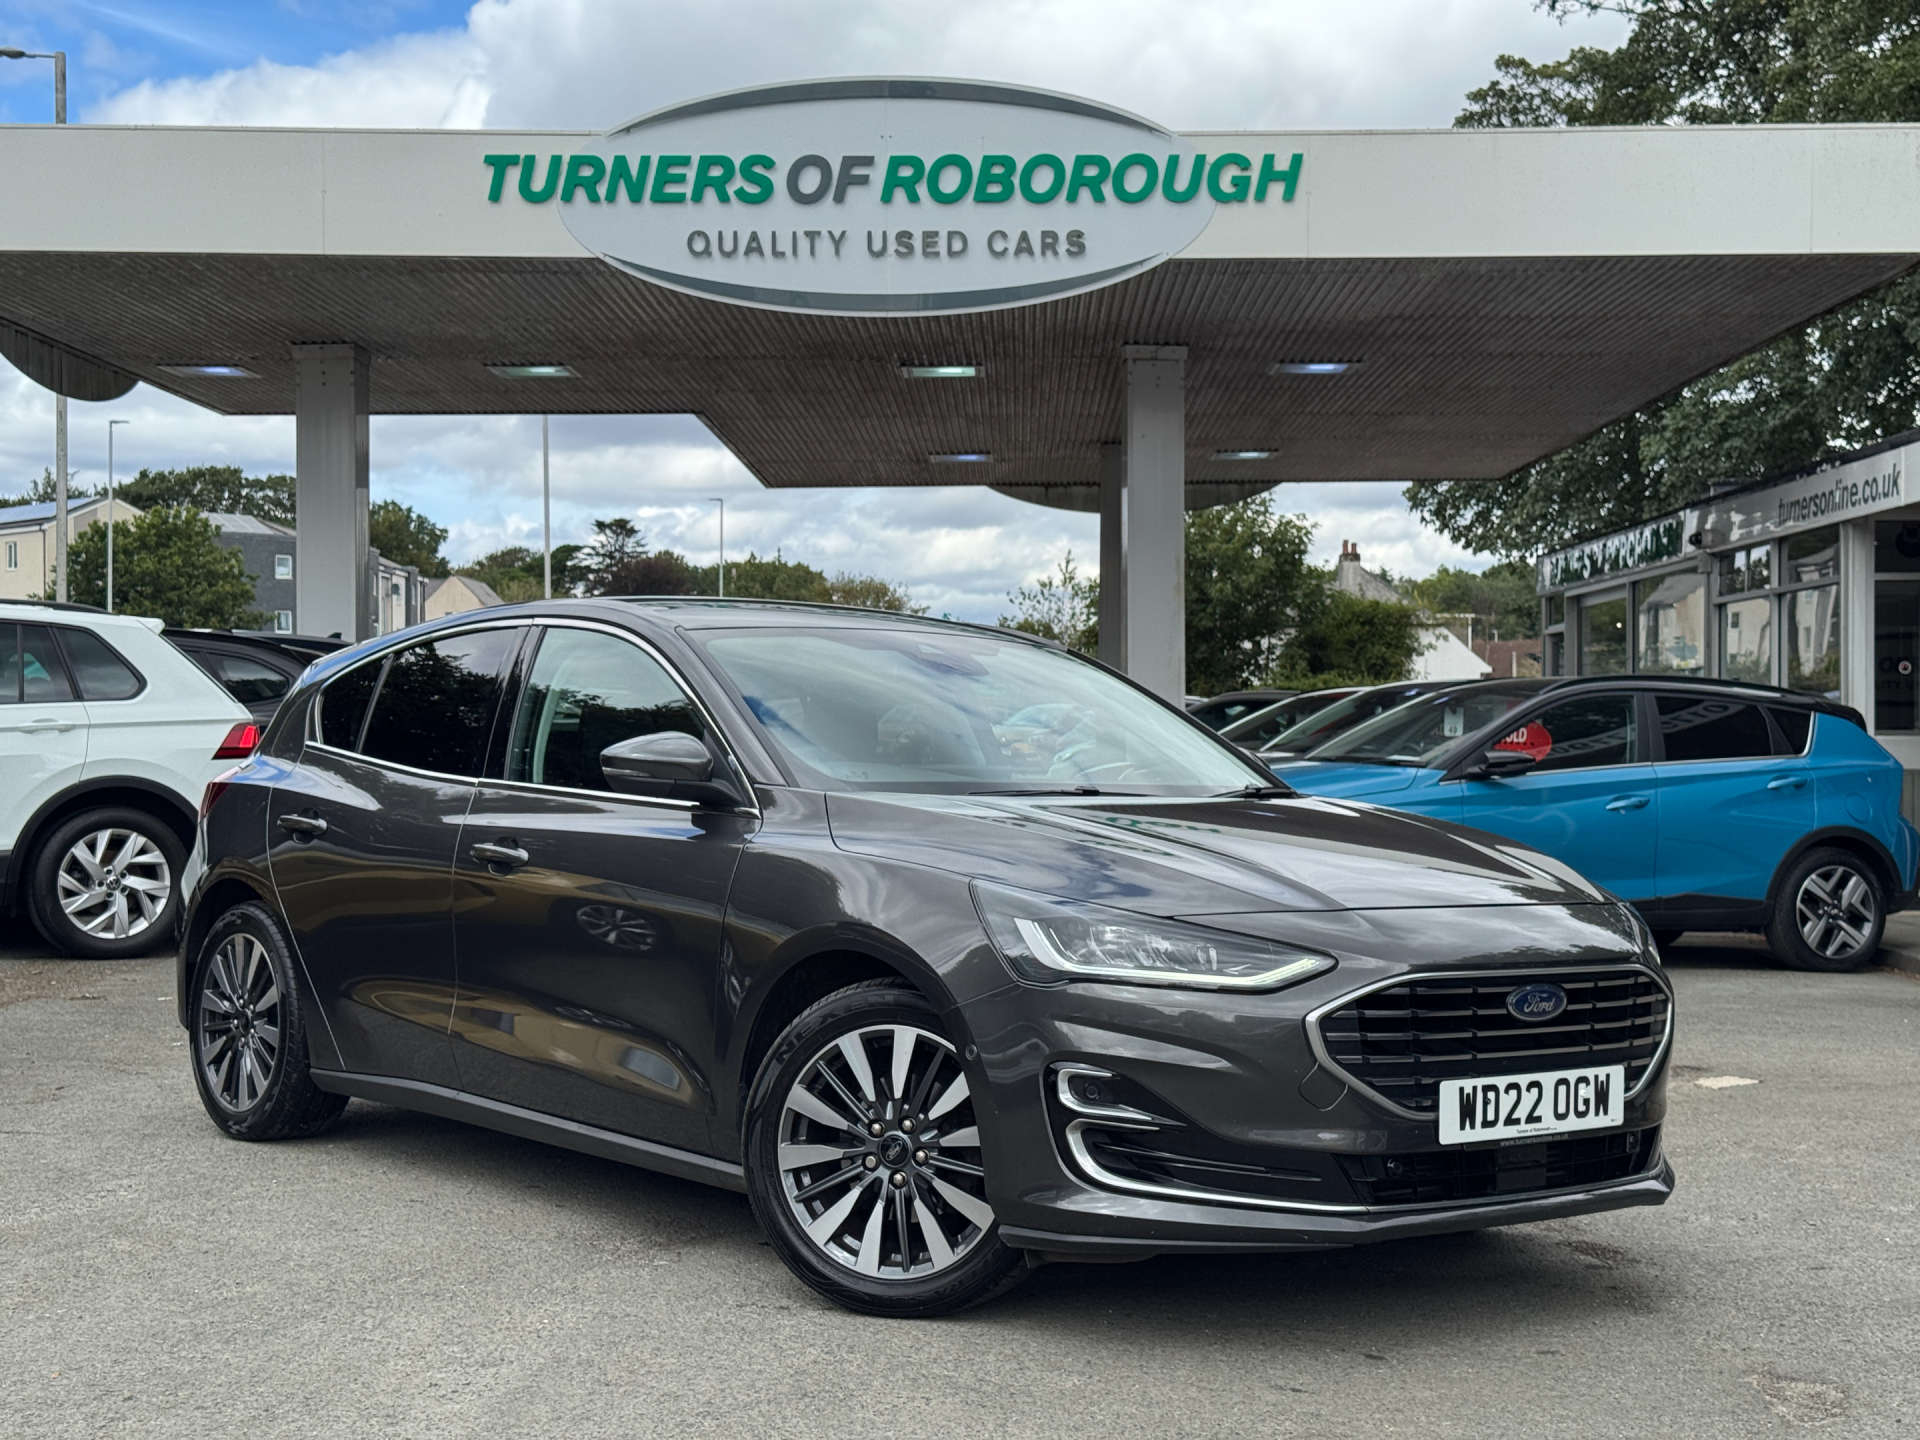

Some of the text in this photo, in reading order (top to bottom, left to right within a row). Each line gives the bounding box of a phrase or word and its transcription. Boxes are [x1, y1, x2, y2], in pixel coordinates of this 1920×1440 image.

[484, 152, 1303, 206] TURNERS OF ROBOROUGH
[686, 229, 1087, 260] QUALITY USED CARS
[1523, 991, 1556, 1013] Ford
[1458, 1073, 1611, 1131] WD22 OGW
